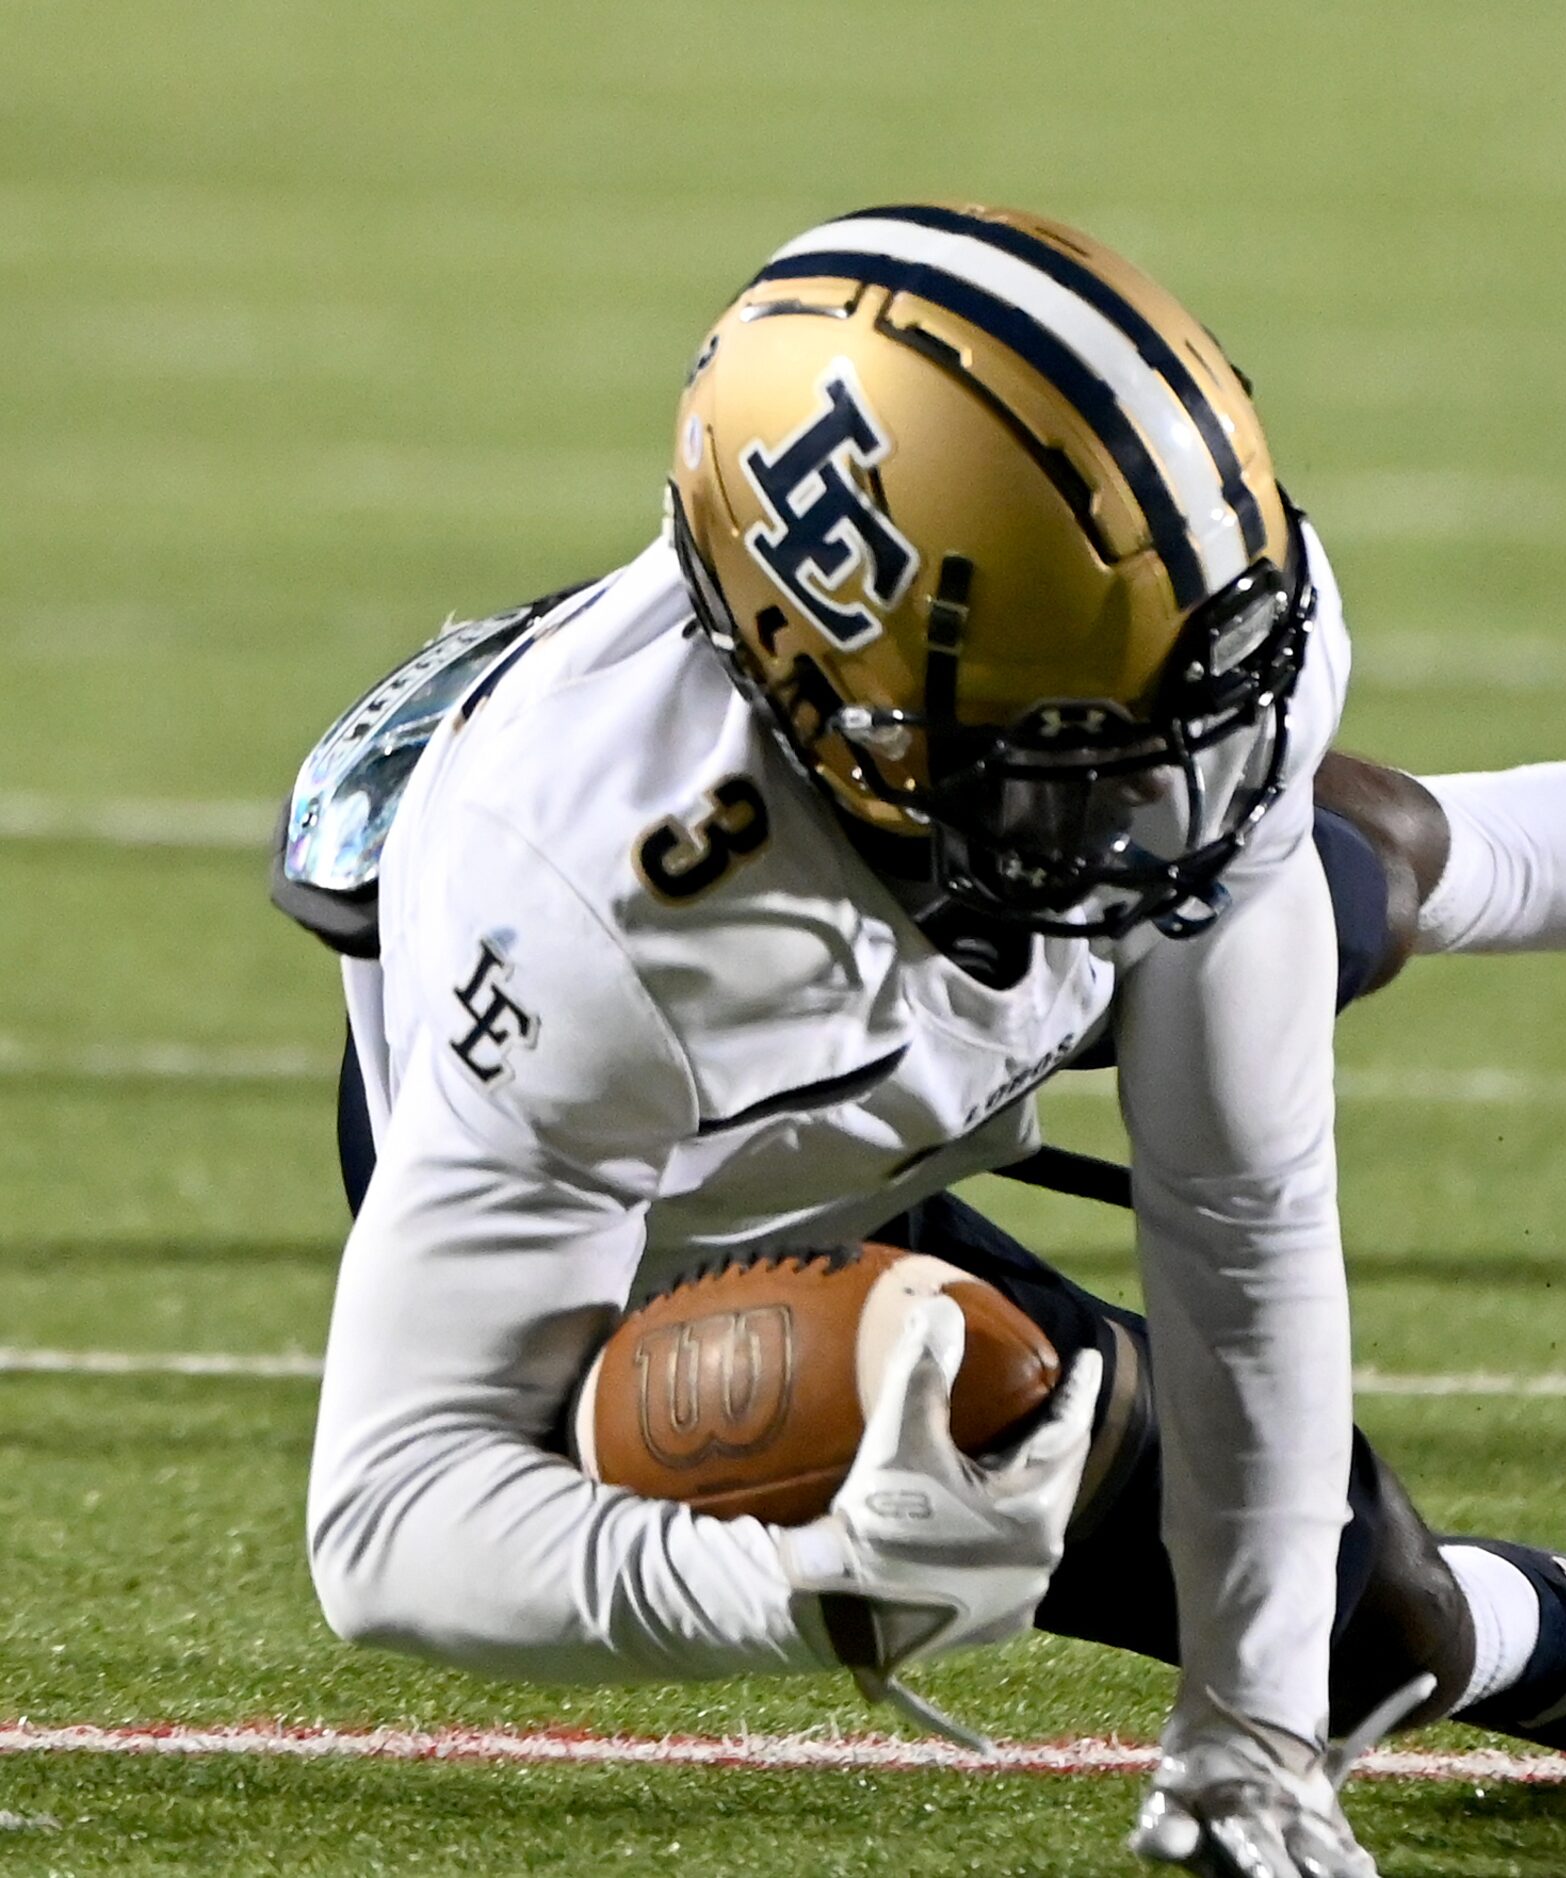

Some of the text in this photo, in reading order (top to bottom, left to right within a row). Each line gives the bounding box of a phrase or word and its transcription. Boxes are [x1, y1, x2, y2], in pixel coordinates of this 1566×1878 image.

[742, 360, 919, 649] LE
[632, 772, 771, 907] 3
[449, 936, 535, 1084] LE
